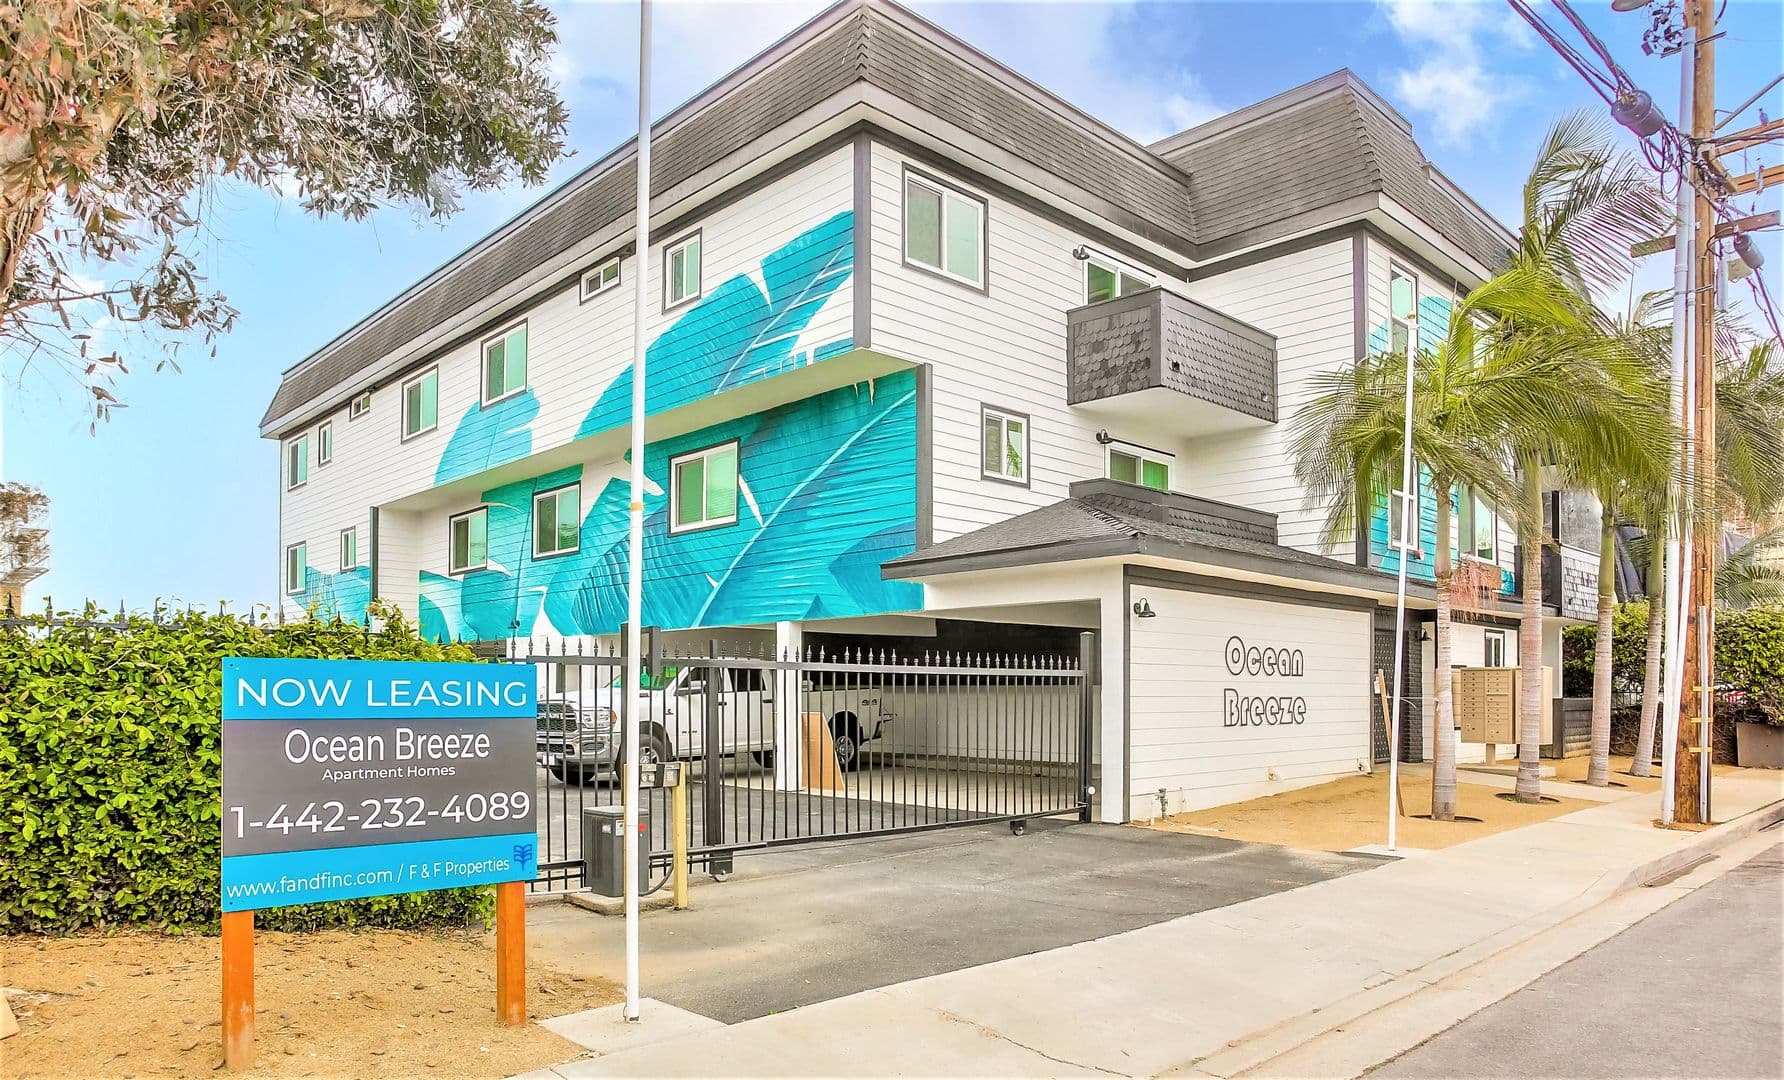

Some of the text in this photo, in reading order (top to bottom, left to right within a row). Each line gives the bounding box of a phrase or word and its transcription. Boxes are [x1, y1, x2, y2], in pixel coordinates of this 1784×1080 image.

[1224, 635, 1304, 677] Ocean
[237, 677, 528, 708] NOW LEASING
[1223, 687, 1307, 727] Breeze
[284, 727, 490, 764] Ocean Breeze
[321, 764, 456, 783] Apartment Homes
[230, 791, 530, 839] 1-442-232-4089
[226, 868, 393, 898] www.fandfinc.com
[409, 863, 418, 880] F
[420, 862, 431, 879] &
[434, 861, 442, 877] F
[446, 857, 510, 878] Properties
